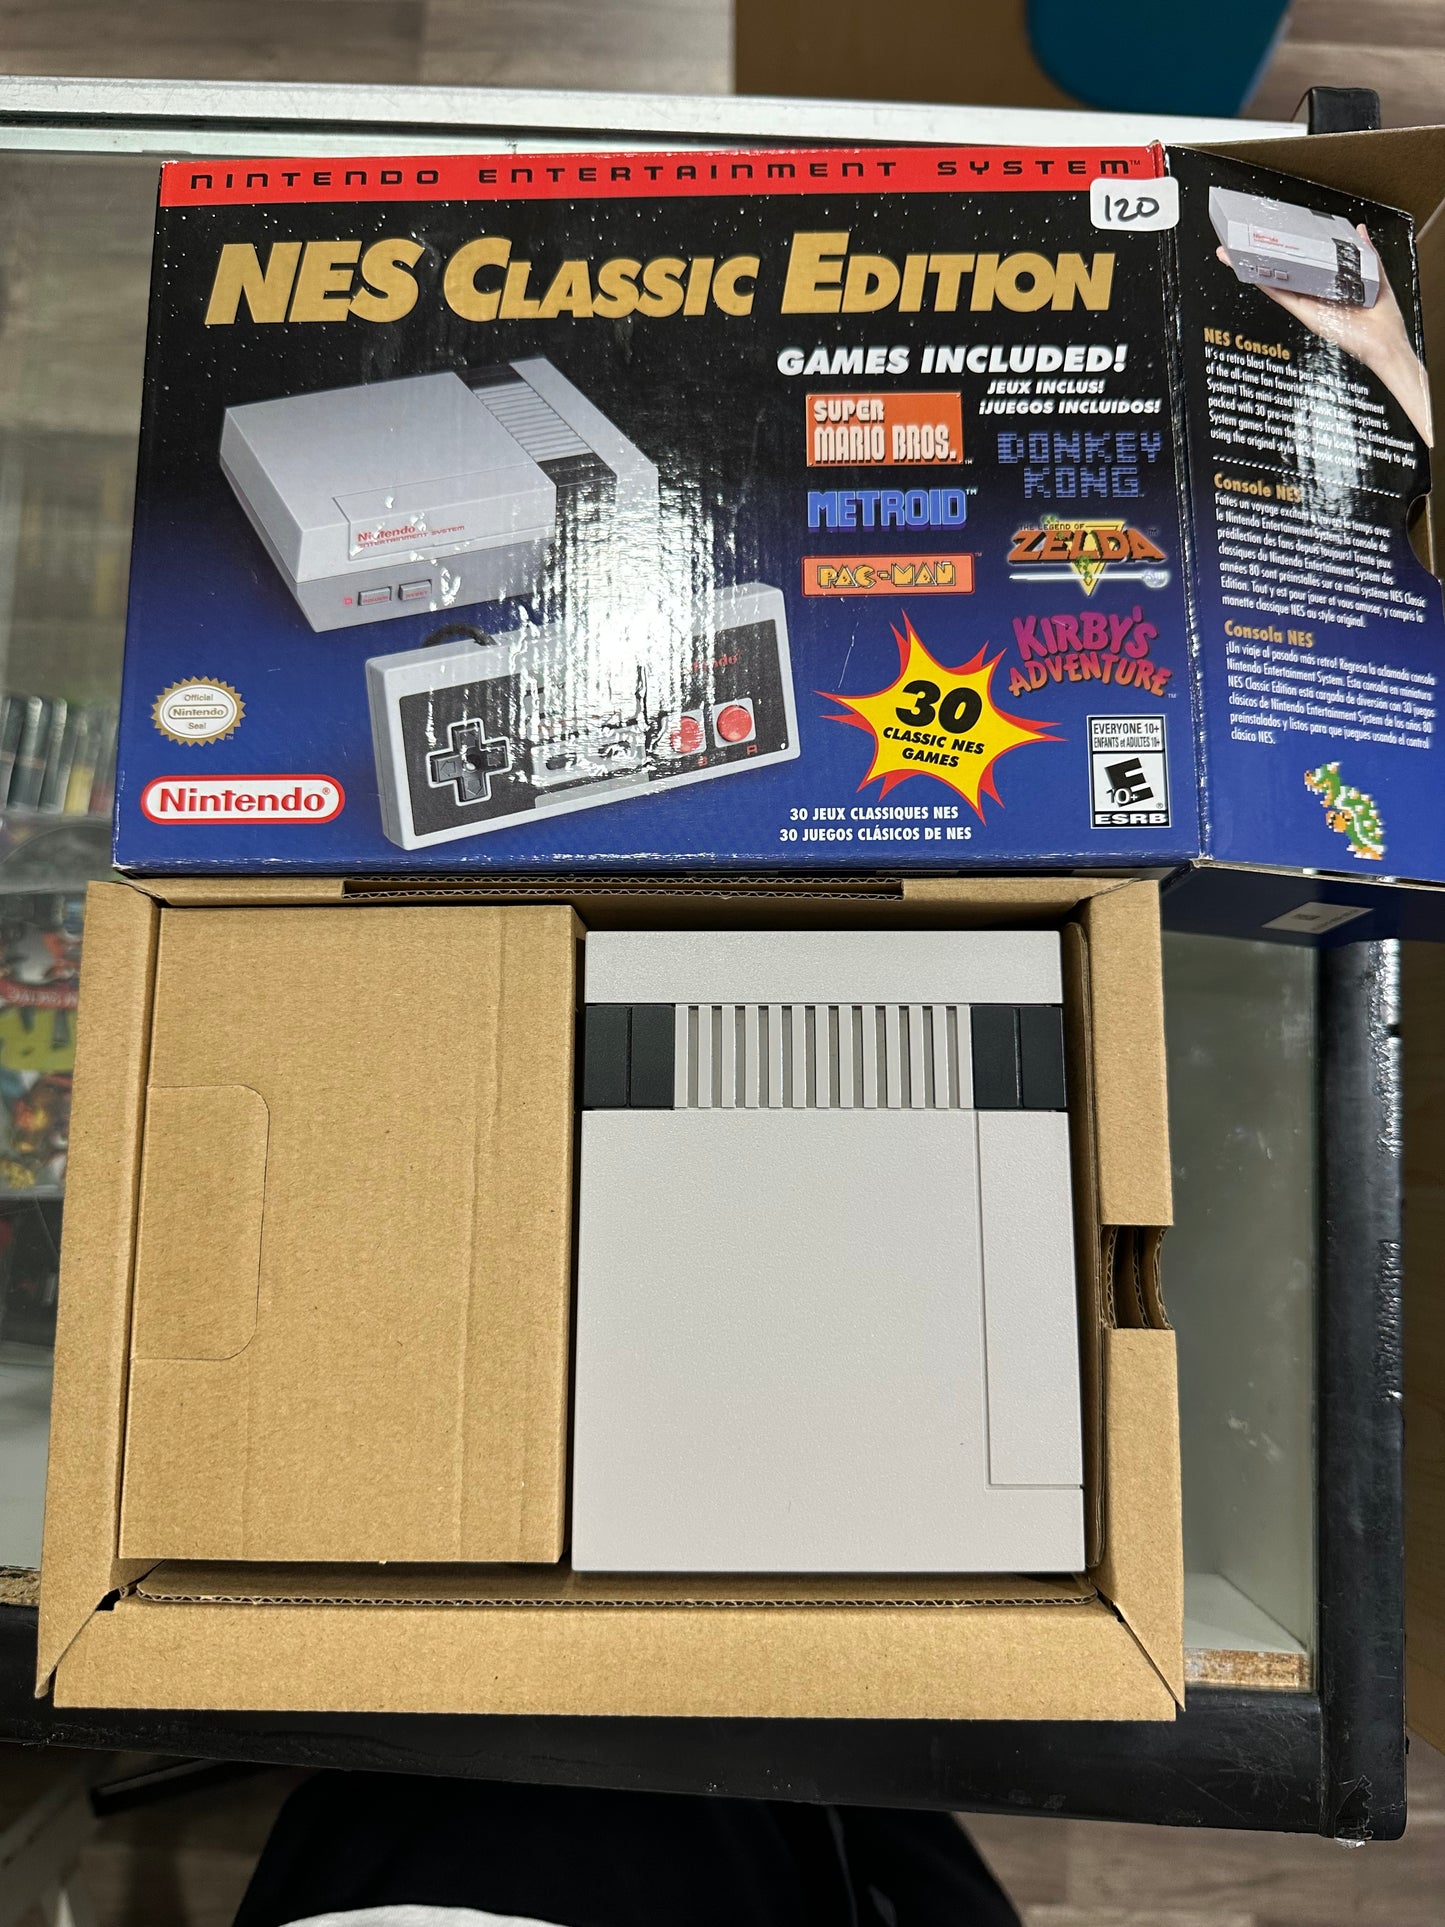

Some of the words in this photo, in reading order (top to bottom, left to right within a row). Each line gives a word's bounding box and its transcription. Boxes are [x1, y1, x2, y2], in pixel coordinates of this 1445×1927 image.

[190, 168, 440, 190] NINTENDO
[478, 158, 897, 184] ENTERTAINMENT
[1104, 195, 1160, 222] 120
[204, 238, 425, 325] NES
[776, 345, 910, 376] GAMES
[920, 343, 1128, 375] INCLUDED!
[1204, 328, 1231, 346] NES
[1235, 335, 1290, 360] Console
[986, 380, 1032, 395] JEUX
[1035, 379, 1106, 395] INCLUS!
[1205, 346, 1218, 359] It's
[1227, 353, 1245, 366] retro
[1247, 354, 1264, 370] blast
[1266, 359, 1284, 374] from
[1286, 364, 1297, 377] the
[1348, 382, 1369, 396] return
[1207, 379, 1237, 395] System!
[1239, 384, 1254, 399] This
[1256, 388, 1292, 408] mini-sized
[1358, 413, 1381, 429] system
[1216, 364, 1228, 378] the
[1231, 368, 1259, 384] all-time
[1261, 372, 1273, 387] fan
[1275, 376, 1302, 394] favorite
[1338, 394, 1384, 414] Entertainment
[813, 400, 885, 423] SUPER
[1057, 398, 1162, 415] INCLUIDOS!
[1208, 396, 1235, 410] packed
[1237, 401, 1253, 414] with
[1255, 404, 1265, 416] 30
[1368, 430, 1414, 451] Entertainment
[1209, 410, 1236, 426] System
[1239, 418, 1263, 431] games
[1265, 421, 1282, 436] from
[1373, 448, 1392, 463] ready
[813, 425, 885, 463] MARIO
[891, 425, 959, 462] BROS.
[996, 431, 1163, 465] DONKEY
[1210, 429, 1231, 444] using
[1233, 430, 1245, 443] the
[1247, 435, 1275, 450] original
[1277, 439, 1294, 455] style
[1023, 467, 1140, 500] KONG
[1214, 473, 1272, 498] Console
[1276, 484, 1302, 503] NES
[1215, 492, 1238, 508] Faites
[1251, 502, 1278, 516] voyage
[1020, 523, 1034, 531] THE
[1038, 523, 1071, 531] LEGEND
[1226, 511, 1260, 528] Nintendo
[1262, 518, 1313, 538] Entertainment
[1353, 538, 1378, 550] console
[1007, 529, 1168, 565] ZELDA
[1218, 526, 1261, 544] prédilection
[1264, 534, 1276, 547] des
[1278, 536, 1294, 550] fans
[1296, 540, 1319, 555] depuis
[1353, 551, 1376, 566] Trente
[1219, 542, 1256, 560] classiques
[1269, 552, 1303, 568] Nintendo
[1305, 558, 1354, 577] Entertainment
[1355, 566, 1380, 582] System
[816, 560, 957, 590] PAC-MAN
[1220, 562, 1248, 575] années
[1249, 564, 1260, 576] 80
[1261, 568, 1277, 580] sont
[1279, 569, 1320, 587] préinstallés
[1361, 586, 1389, 602] système
[1405, 591, 1426, 608] Classic
[1221, 575, 1250, 591] Edition.
[1251, 581, 1268, 594] Tout
[1289, 590, 1306, 602] pour
[1308, 589, 1327, 604] jouer
[1390, 609, 1415, 622] compris
[1222, 596, 1254, 609] manette
[1256, 598, 1289, 615] classique
[1290, 604, 1305, 616] NES
[1318, 608, 1335, 623] style
[1011, 605, 1159, 661] KIRBY'S
[1224, 620, 1282, 643] Consola
[1287, 630, 1314, 648] NES
[1008, 653, 1173, 698] ADVENTURE
[1227, 658, 1261, 674] Nintendo
[1264, 663, 1315, 682] Entertainment
[1317, 671, 1345, 686] System.
[1347, 676, 1361, 689] Esta
[1363, 681, 1388, 693] consola
[1400, 687, 1432, 701] miniatura
[1242, 644, 1260, 659] viaje
[1272, 650, 1298, 662] pasado
[1300, 653, 1315, 665] más
[1317, 657, 1337, 669] retro!
[1340, 658, 1367, 674] Regresa
[1377, 665, 1410, 681] aclamada
[1411, 673, 1435, 686] consola
[172, 708, 224, 717] Nintendo
[184, 693, 214, 702] Official
[895, 680, 982, 734] 30
[1228, 675, 1243, 689] NES
[1245, 678, 1270, 692] Classic
[1272, 681, 1297, 696] Edition
[1316, 690, 1344, 704] cargada
[1357, 694, 1388, 710] diversión
[1414, 704, 1435, 719] juegos
[1229, 692, 1258, 708] clásicos
[1271, 698, 1304, 714] Nintendo
[1306, 703, 1357, 721] Entertainment
[1358, 711, 1383, 725] System
[188, 722, 207, 730] Seal
[882, 726, 947, 750] CLASSIC
[951, 738, 986, 755] NES
[1093, 723, 1142, 735] EVERYONE
[1144, 723, 1160, 734] 10+
[1230, 712, 1281, 728] preinstalados
[1289, 717, 1308, 732] listos
[1310, 723, 1327, 735] para
[1344, 726, 1371, 741] juegues
[1373, 731, 1397, 744] usando
[1406, 737, 1430, 749] control
[1231, 726, 1256, 742] clásico
[1258, 731, 1276, 744] NES.
[902, 748, 960, 768] GAMES
[1094, 737, 1119, 748] ENFANTS
[1120, 738, 1126, 748] et
[1126, 737, 1151, 748] ADULTES
[1104, 757, 1154, 808] E
[1106, 788, 1138, 804] 10+
[789, 808, 809, 822] 30
[813, 807, 847, 821] JEUX
[850, 806, 931, 822] CLASSIQUES
[934, 806, 959, 819] NES
[1095, 813, 1167, 825] ESRB
[779, 828, 798, 842] 30
[802, 827, 853, 841] JUEGOS
[857, 823, 921, 841] CLÁSICOS
[925, 827, 942, 840] DE
[946, 827, 971, 840] NES
